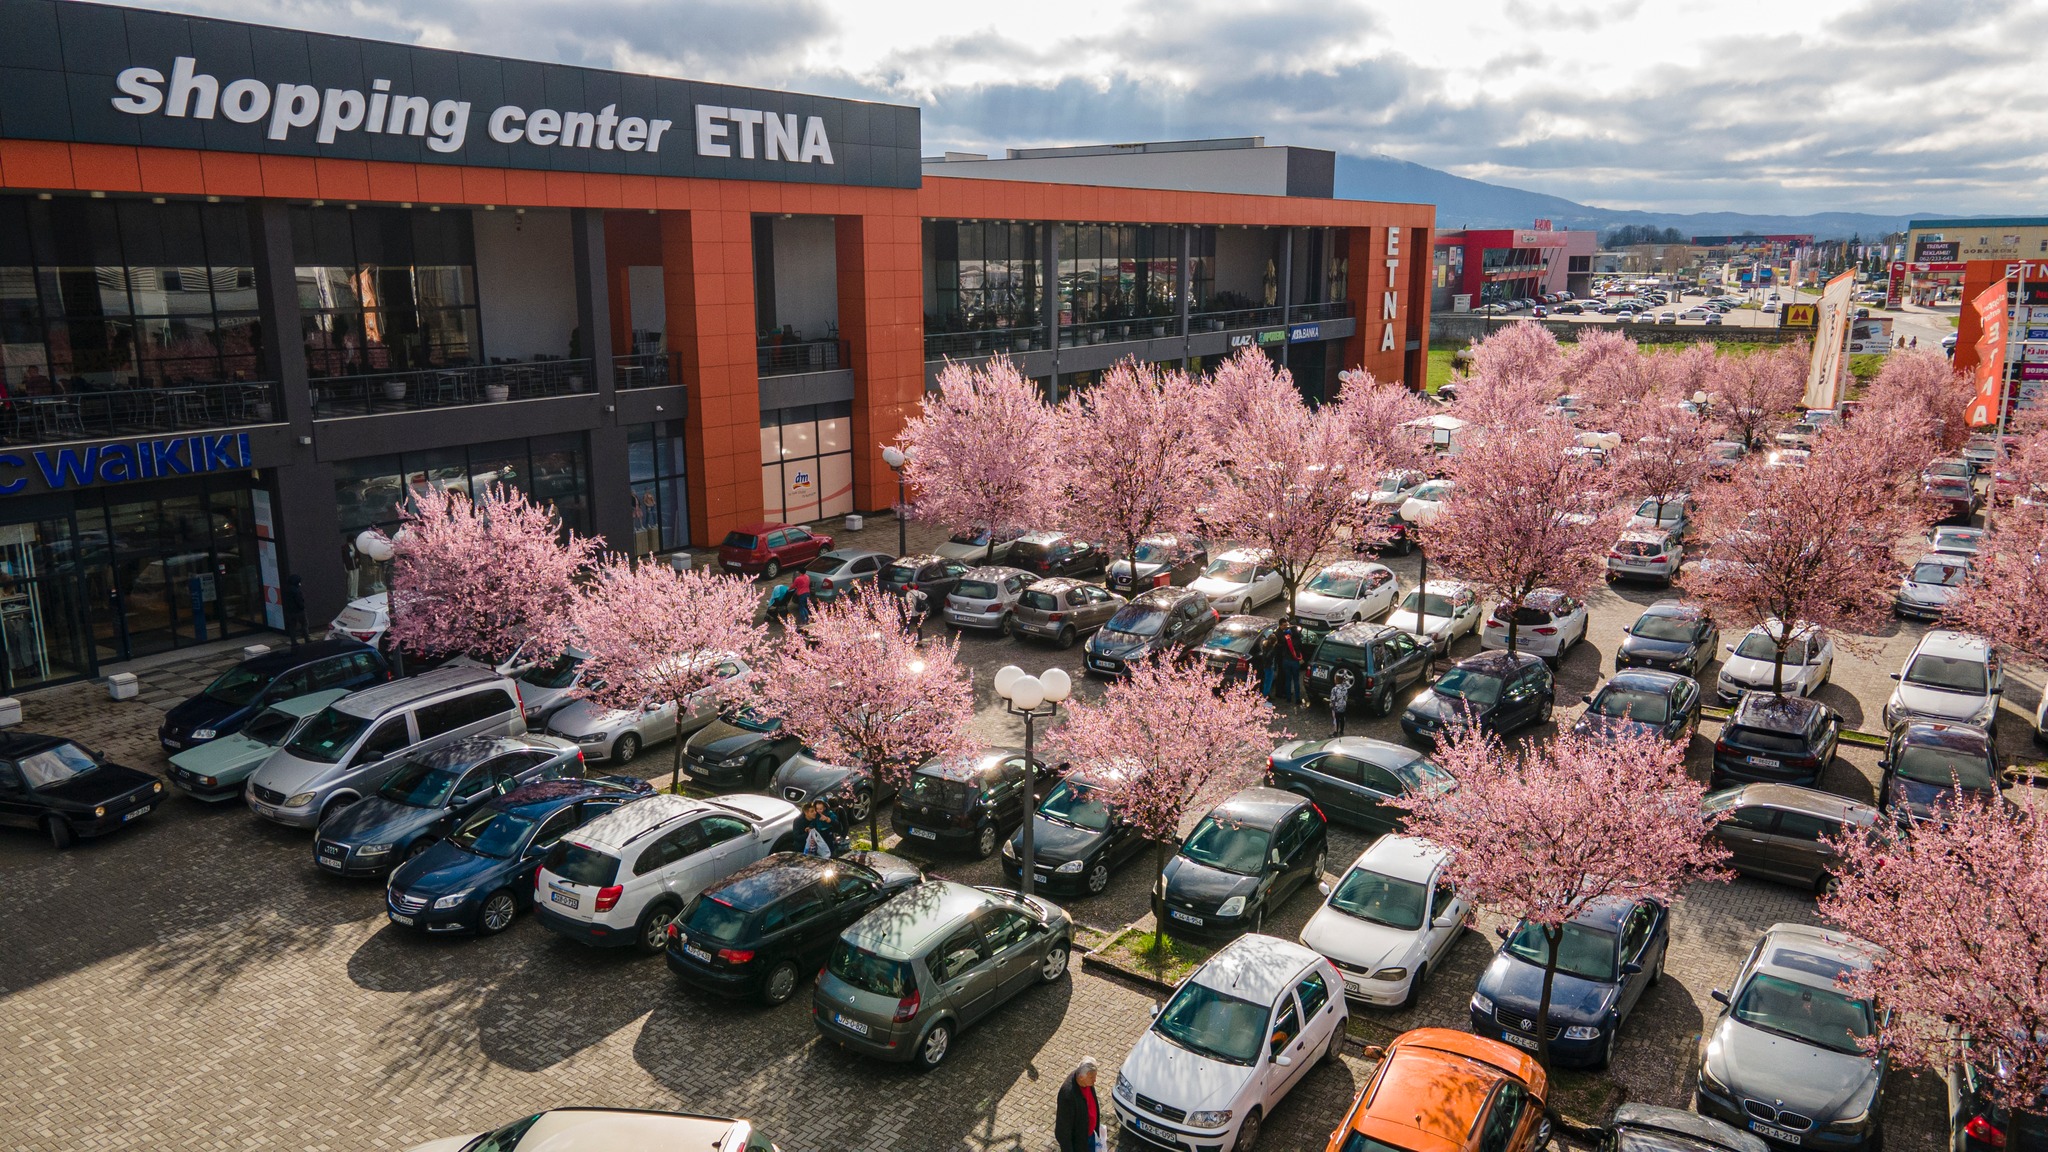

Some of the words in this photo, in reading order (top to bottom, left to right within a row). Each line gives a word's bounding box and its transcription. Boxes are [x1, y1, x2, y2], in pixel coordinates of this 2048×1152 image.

[112, 56, 471, 153] shopping
[488, 103, 672, 153] center
[695, 104, 835, 165] ETNA
[1381, 227, 1400, 352] ETNA
[795, 472, 809, 484] dm
[1755, 1122, 1800, 1143] M91-A-219
